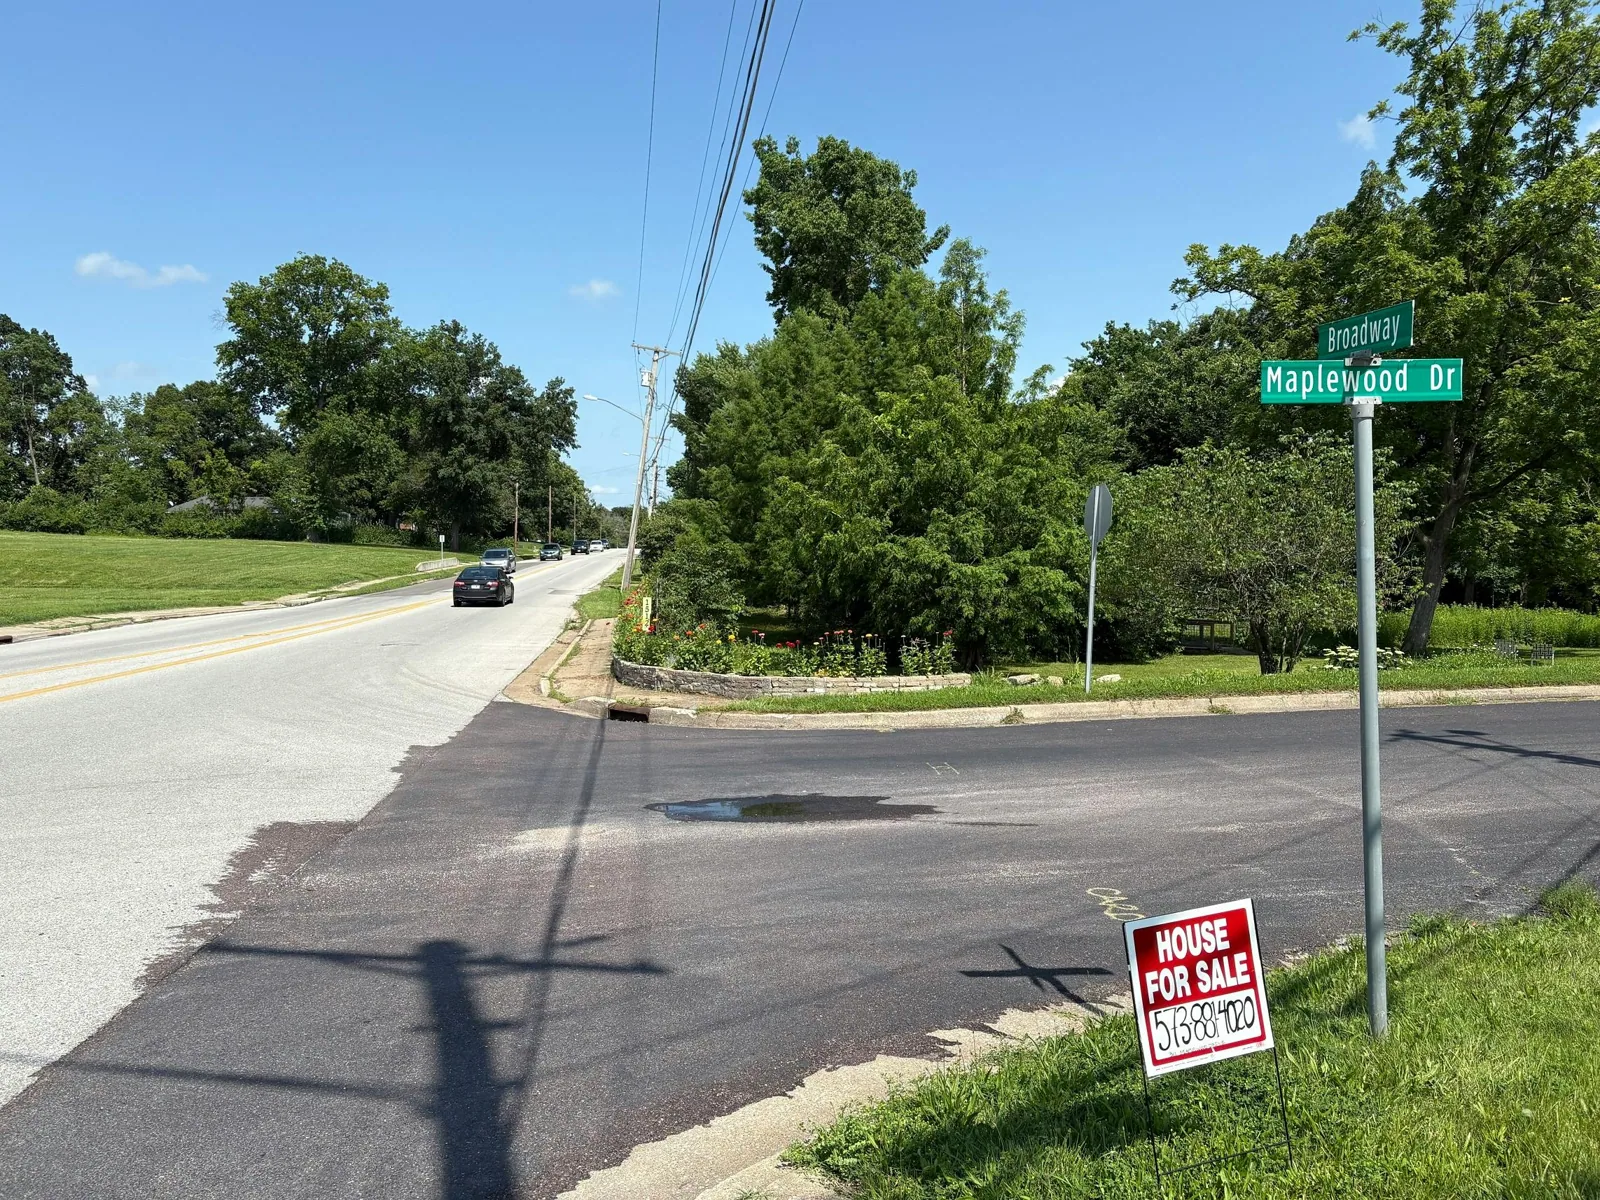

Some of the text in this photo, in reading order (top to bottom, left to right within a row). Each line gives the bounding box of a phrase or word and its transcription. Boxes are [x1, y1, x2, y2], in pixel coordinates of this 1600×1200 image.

[1328, 314, 1400, 353] Broadway
[1266, 363, 1456, 400] Maplewood Dr
[1155, 917, 1230, 963] HOUSE
[1145, 952, 1251, 1005] FOR SALE
